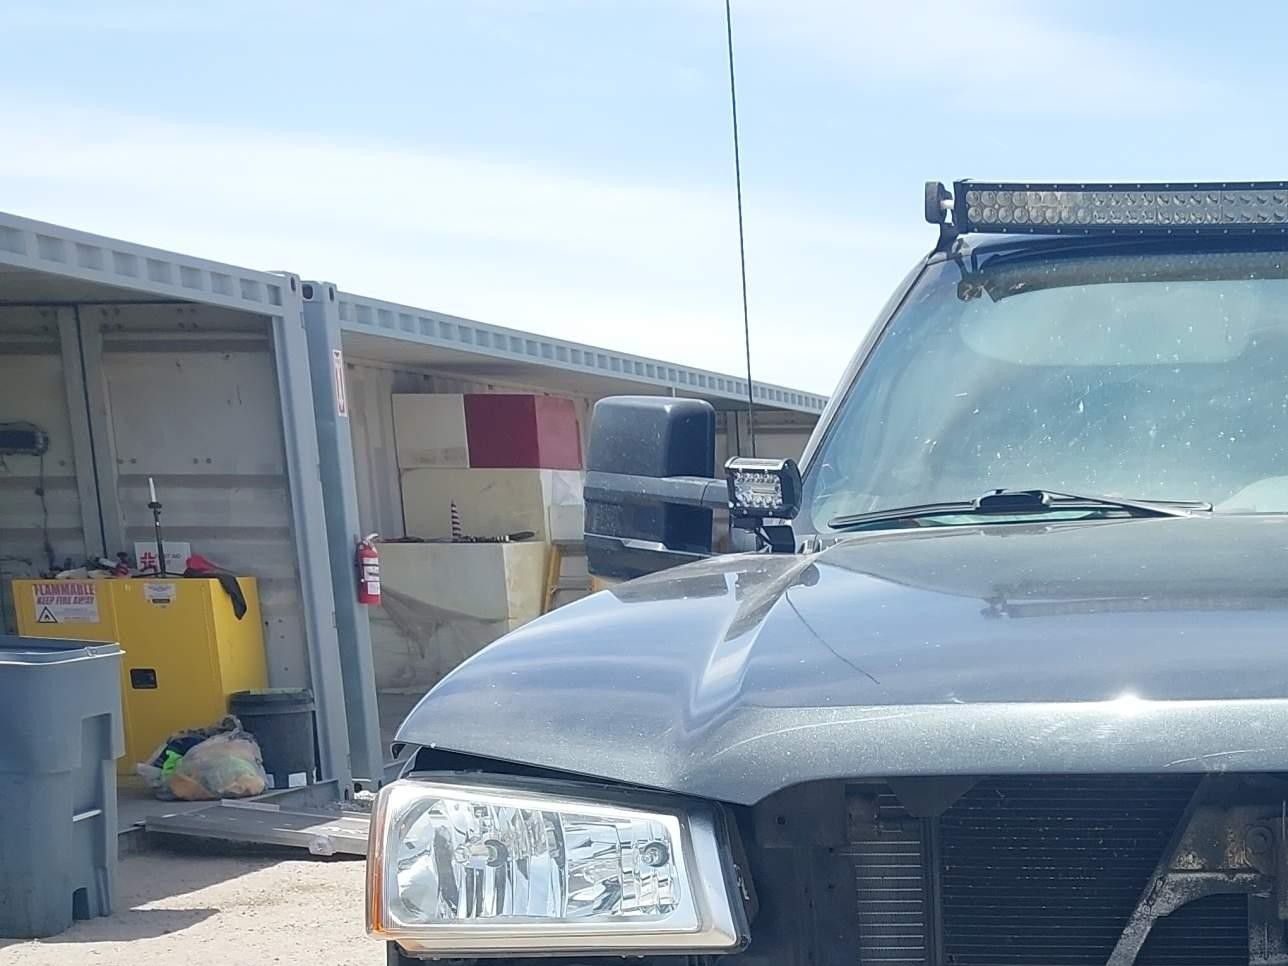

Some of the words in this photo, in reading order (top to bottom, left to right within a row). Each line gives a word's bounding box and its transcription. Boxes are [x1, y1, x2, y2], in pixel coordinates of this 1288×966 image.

[34, 583, 95, 596] FLAMMABLE
[37, 596, 54, 605] KEEP
[56, 596, 71, 605] FIRE
[72, 596, 94, 605] AWAY
